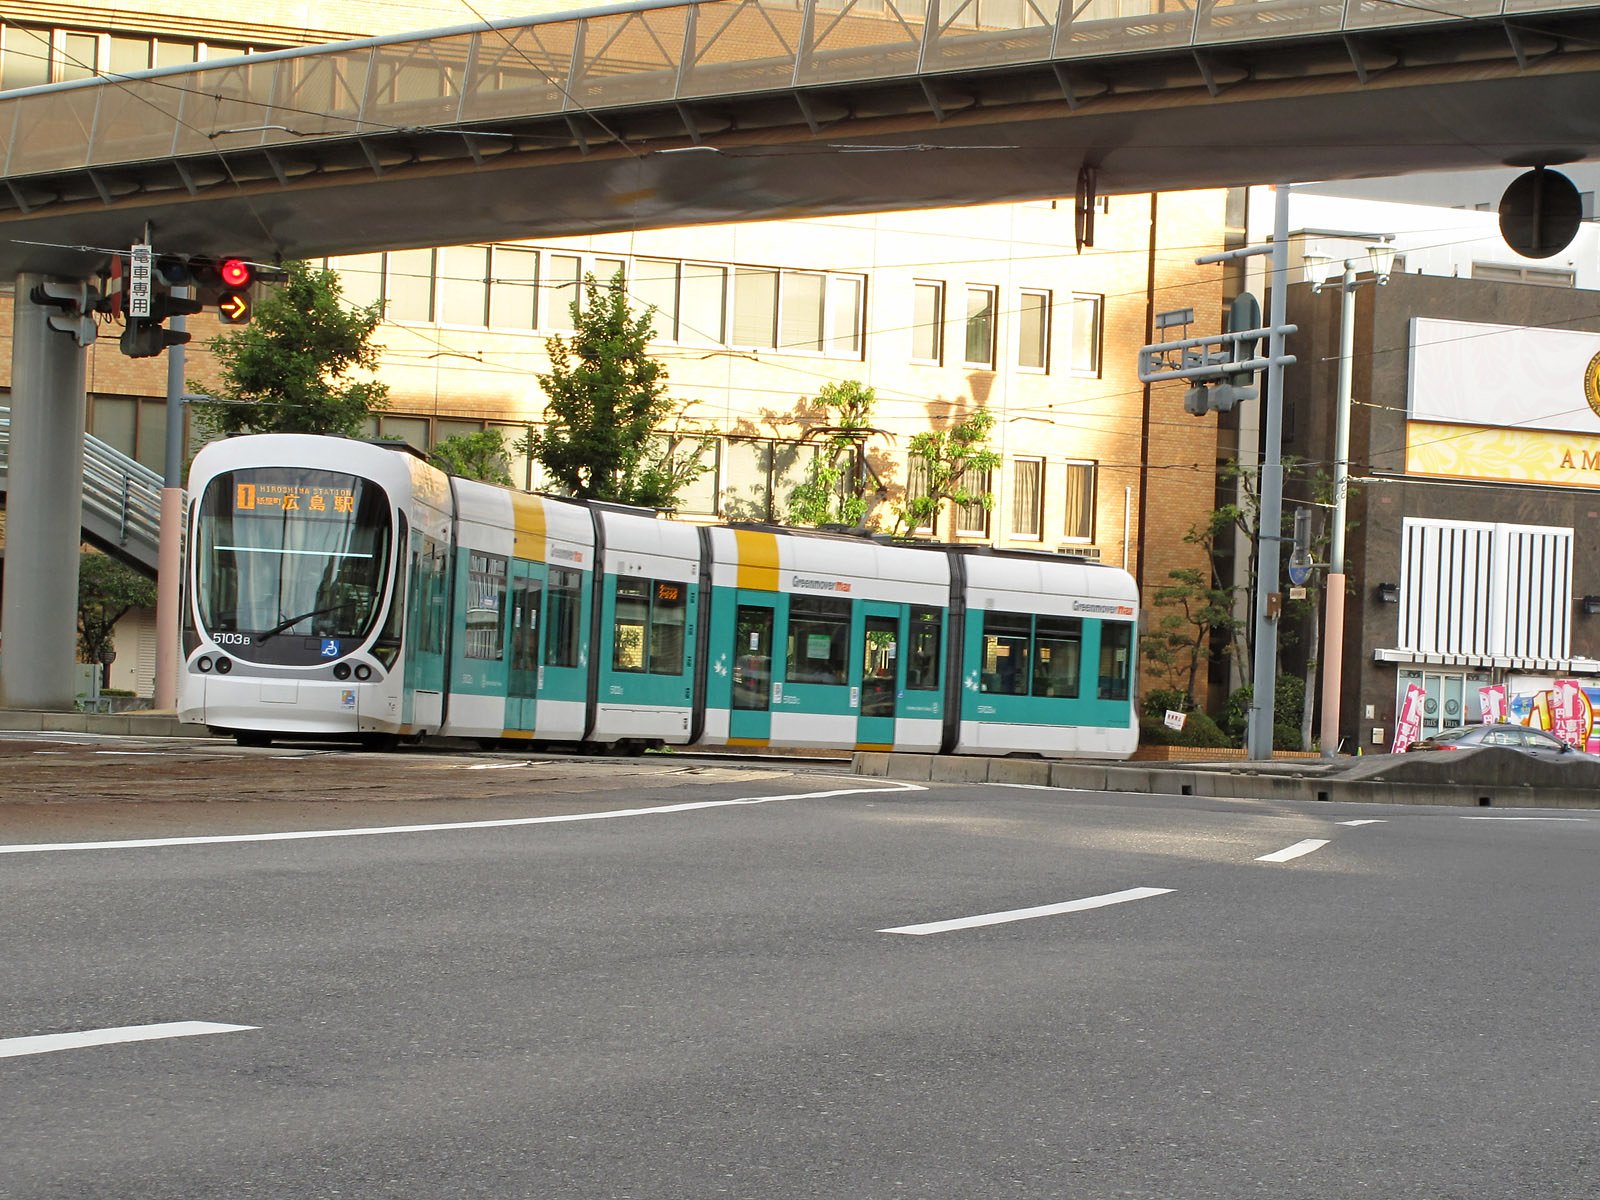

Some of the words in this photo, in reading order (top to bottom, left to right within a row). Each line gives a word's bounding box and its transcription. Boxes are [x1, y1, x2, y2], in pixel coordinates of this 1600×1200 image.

[132, 248, 150, 313] 電車専用
[260, 484, 310, 495] HIROSHIMA
[313, 488, 352, 497] STATION
[282, 494, 354, 512] 広島駅
